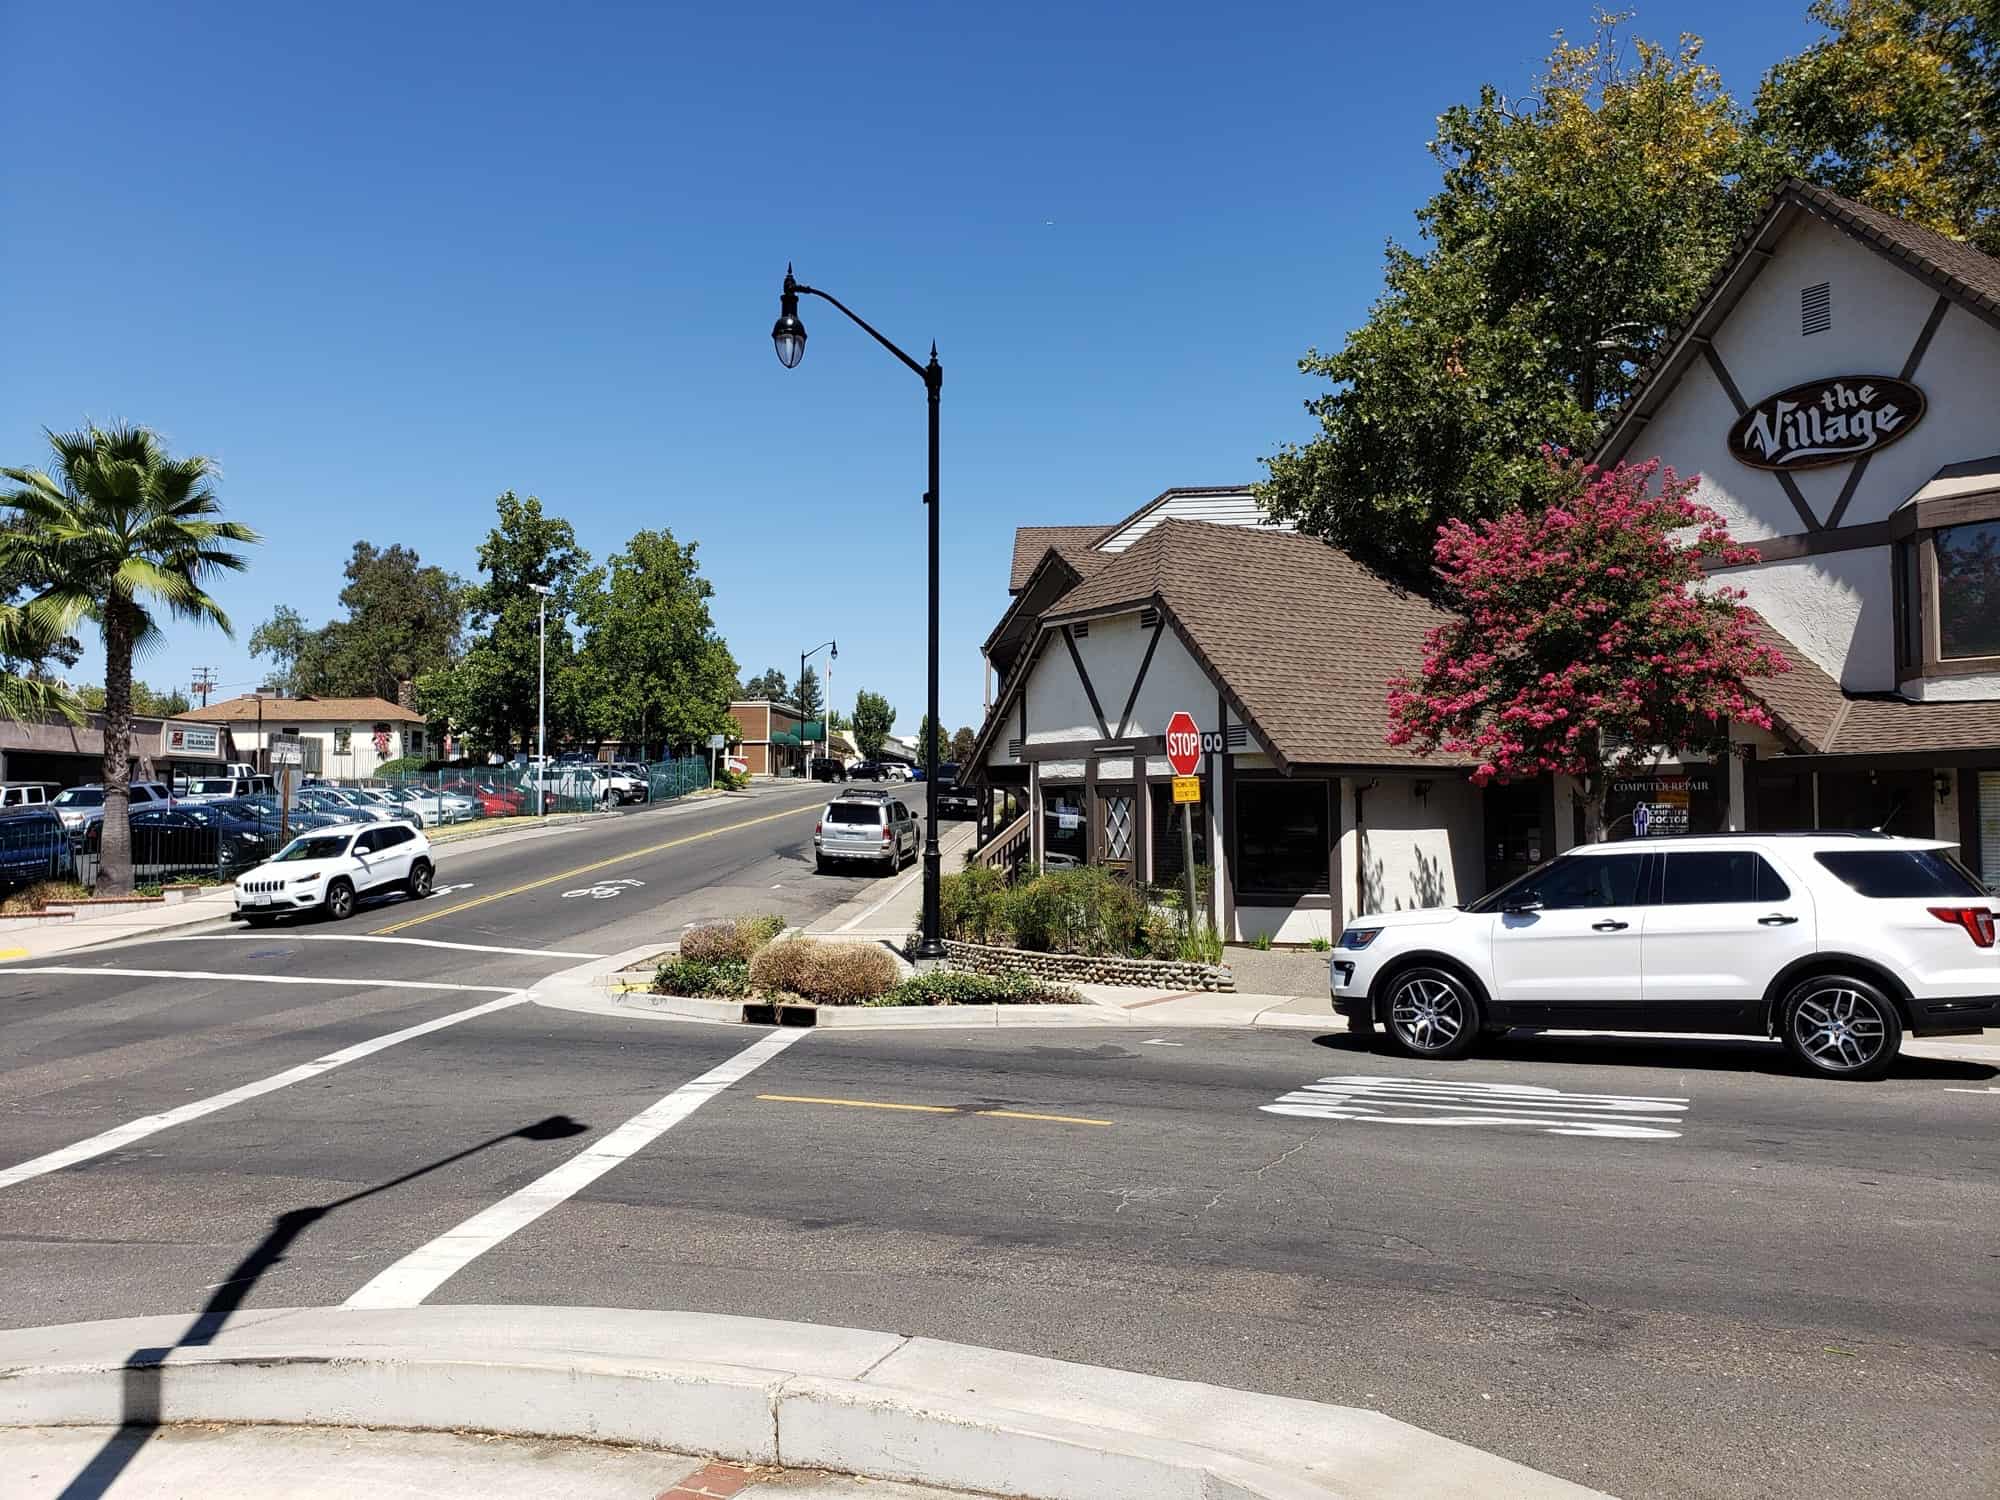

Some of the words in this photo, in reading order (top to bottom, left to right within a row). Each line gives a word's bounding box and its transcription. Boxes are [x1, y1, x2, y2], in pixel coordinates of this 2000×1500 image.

[1821, 383, 1880, 411] the
[1744, 400, 1904, 464] Village
[1169, 733, 1198, 756] STOP
[1613, 782, 1670, 792] COMPUTER
[1671, 781, 1710, 791] REPAIR
[1649, 816, 1687, 824] DOCTOR
